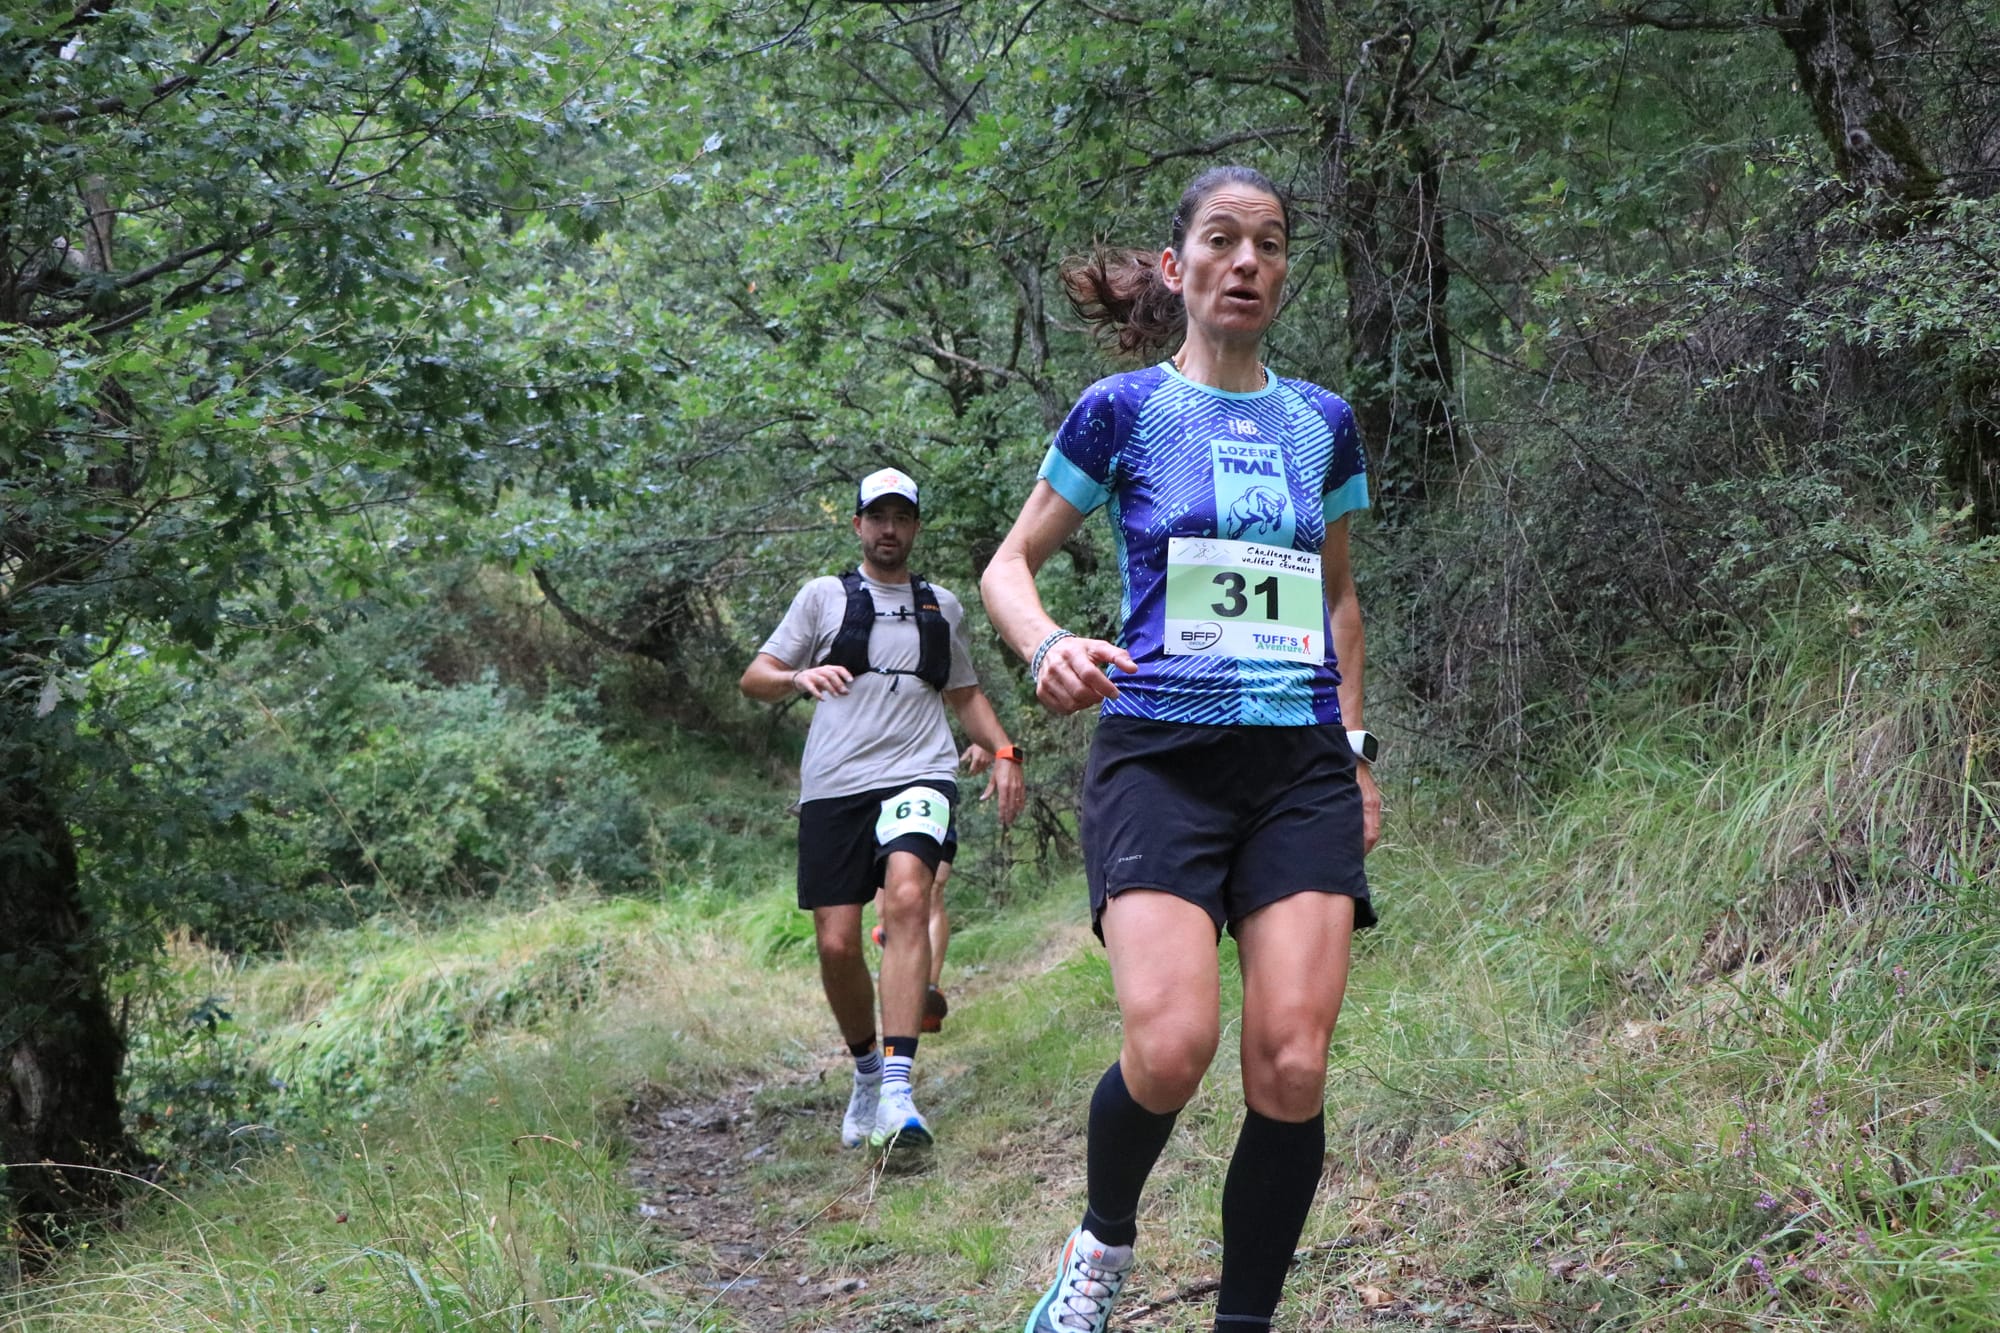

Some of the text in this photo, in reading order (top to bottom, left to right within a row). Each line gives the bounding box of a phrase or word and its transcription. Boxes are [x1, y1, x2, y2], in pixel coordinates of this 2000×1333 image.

[1218, 445, 1278, 459] LOZÈRE
[1218, 457, 1281, 477] TRAIL
[1247, 546, 1311, 564] Challenge des
[1242, 556, 1315, 574] vallées cévenoles
[1211, 571, 1279, 621] 31
[1181, 631, 1217, 641] BFP
[1252, 633, 1299, 647] TUFF'S
[895, 799, 932, 820] 63
